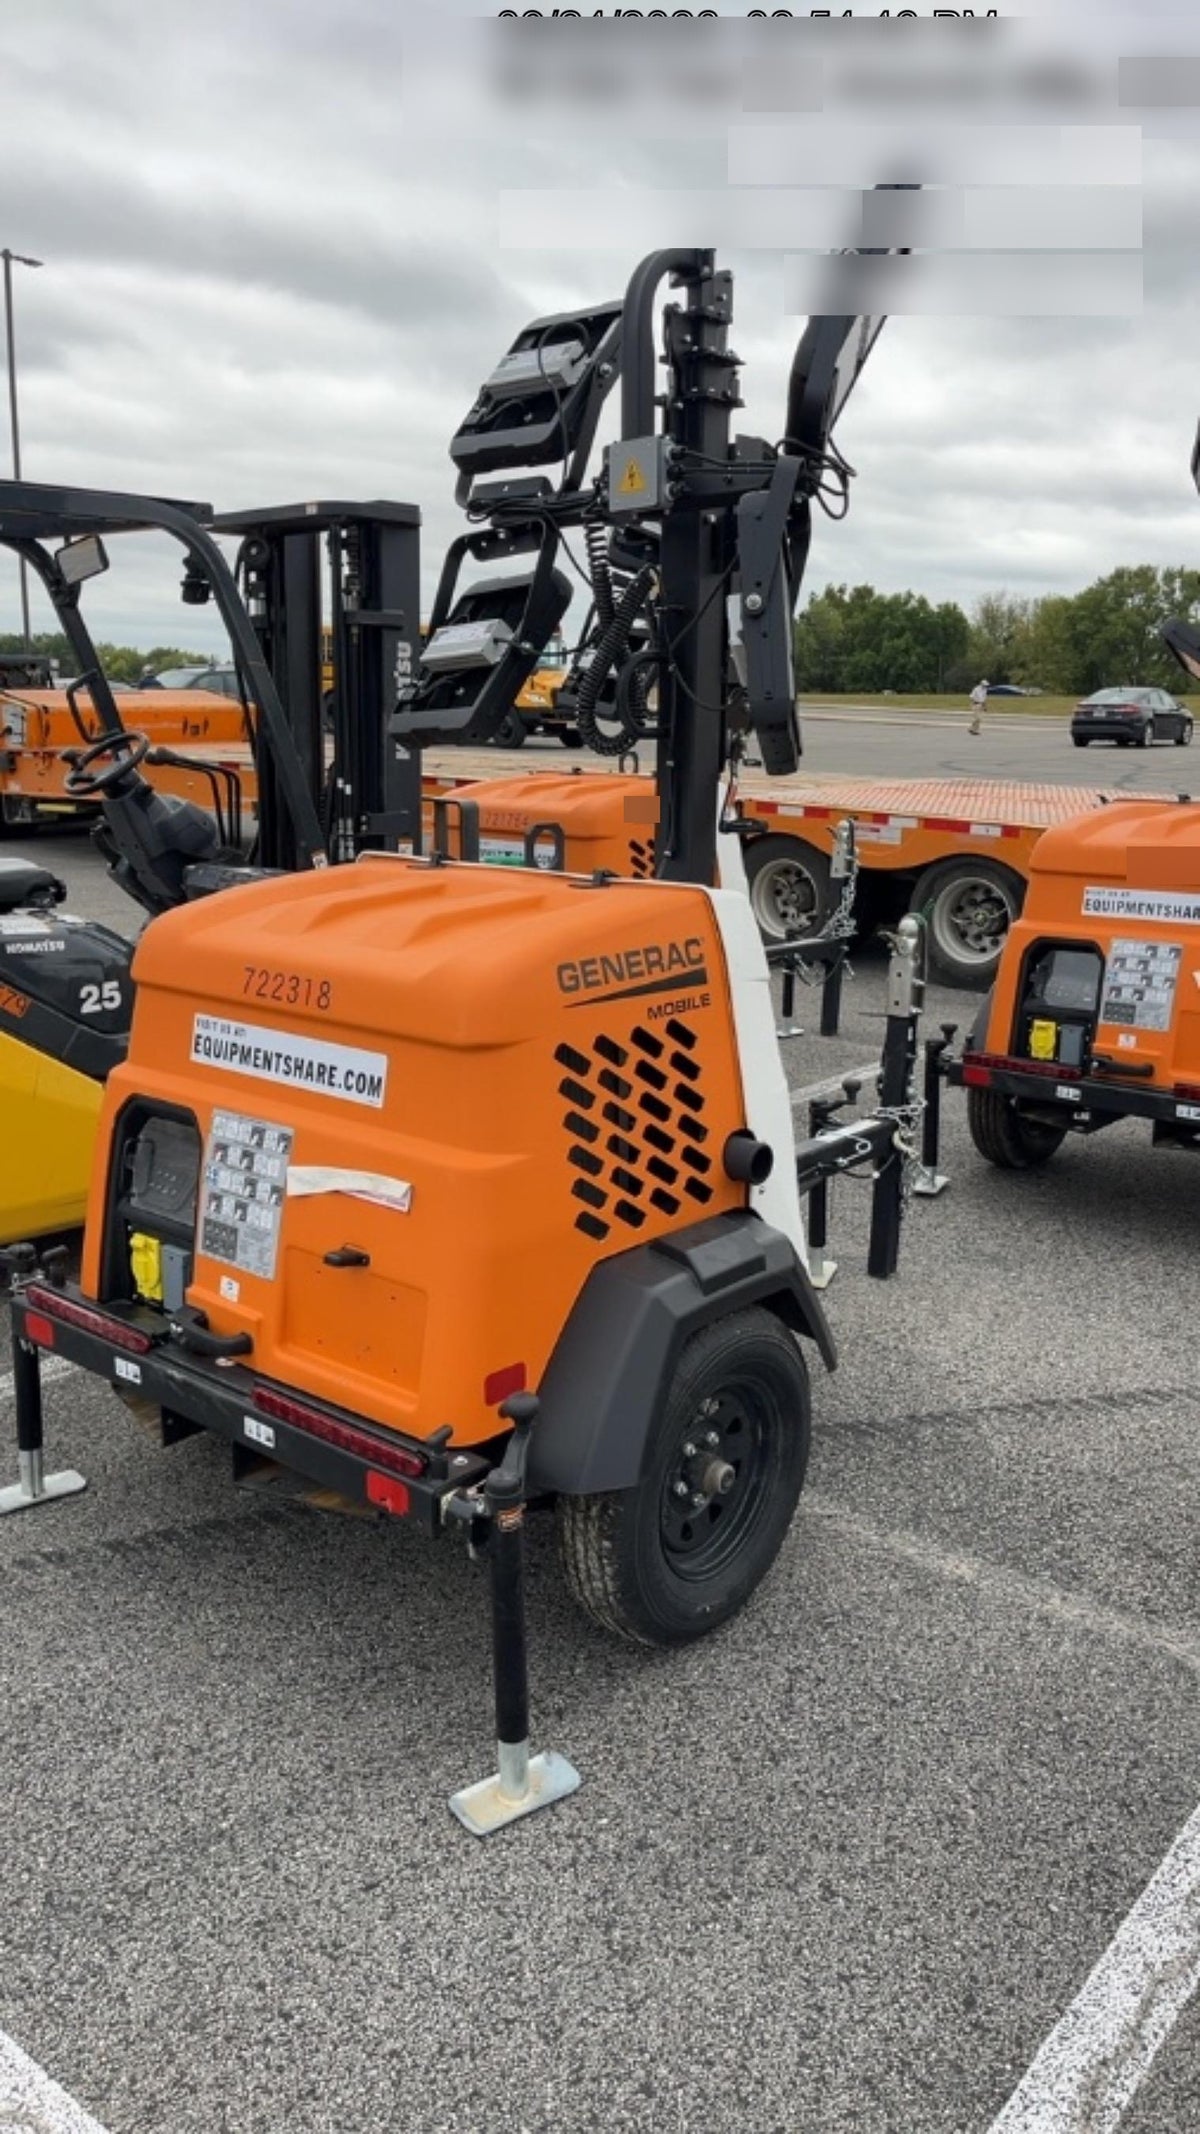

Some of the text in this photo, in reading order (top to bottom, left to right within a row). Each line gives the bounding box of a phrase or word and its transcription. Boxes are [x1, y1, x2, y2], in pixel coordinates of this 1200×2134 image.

[557, 938, 704, 993] GENERAC
[79, 980, 121, 1014] 25
[243, 967, 332, 1010] 722318
[647, 993, 711, 1020] MOBILE
[194, 1034, 382, 1098] EQUIPMENTSHARE.COM
